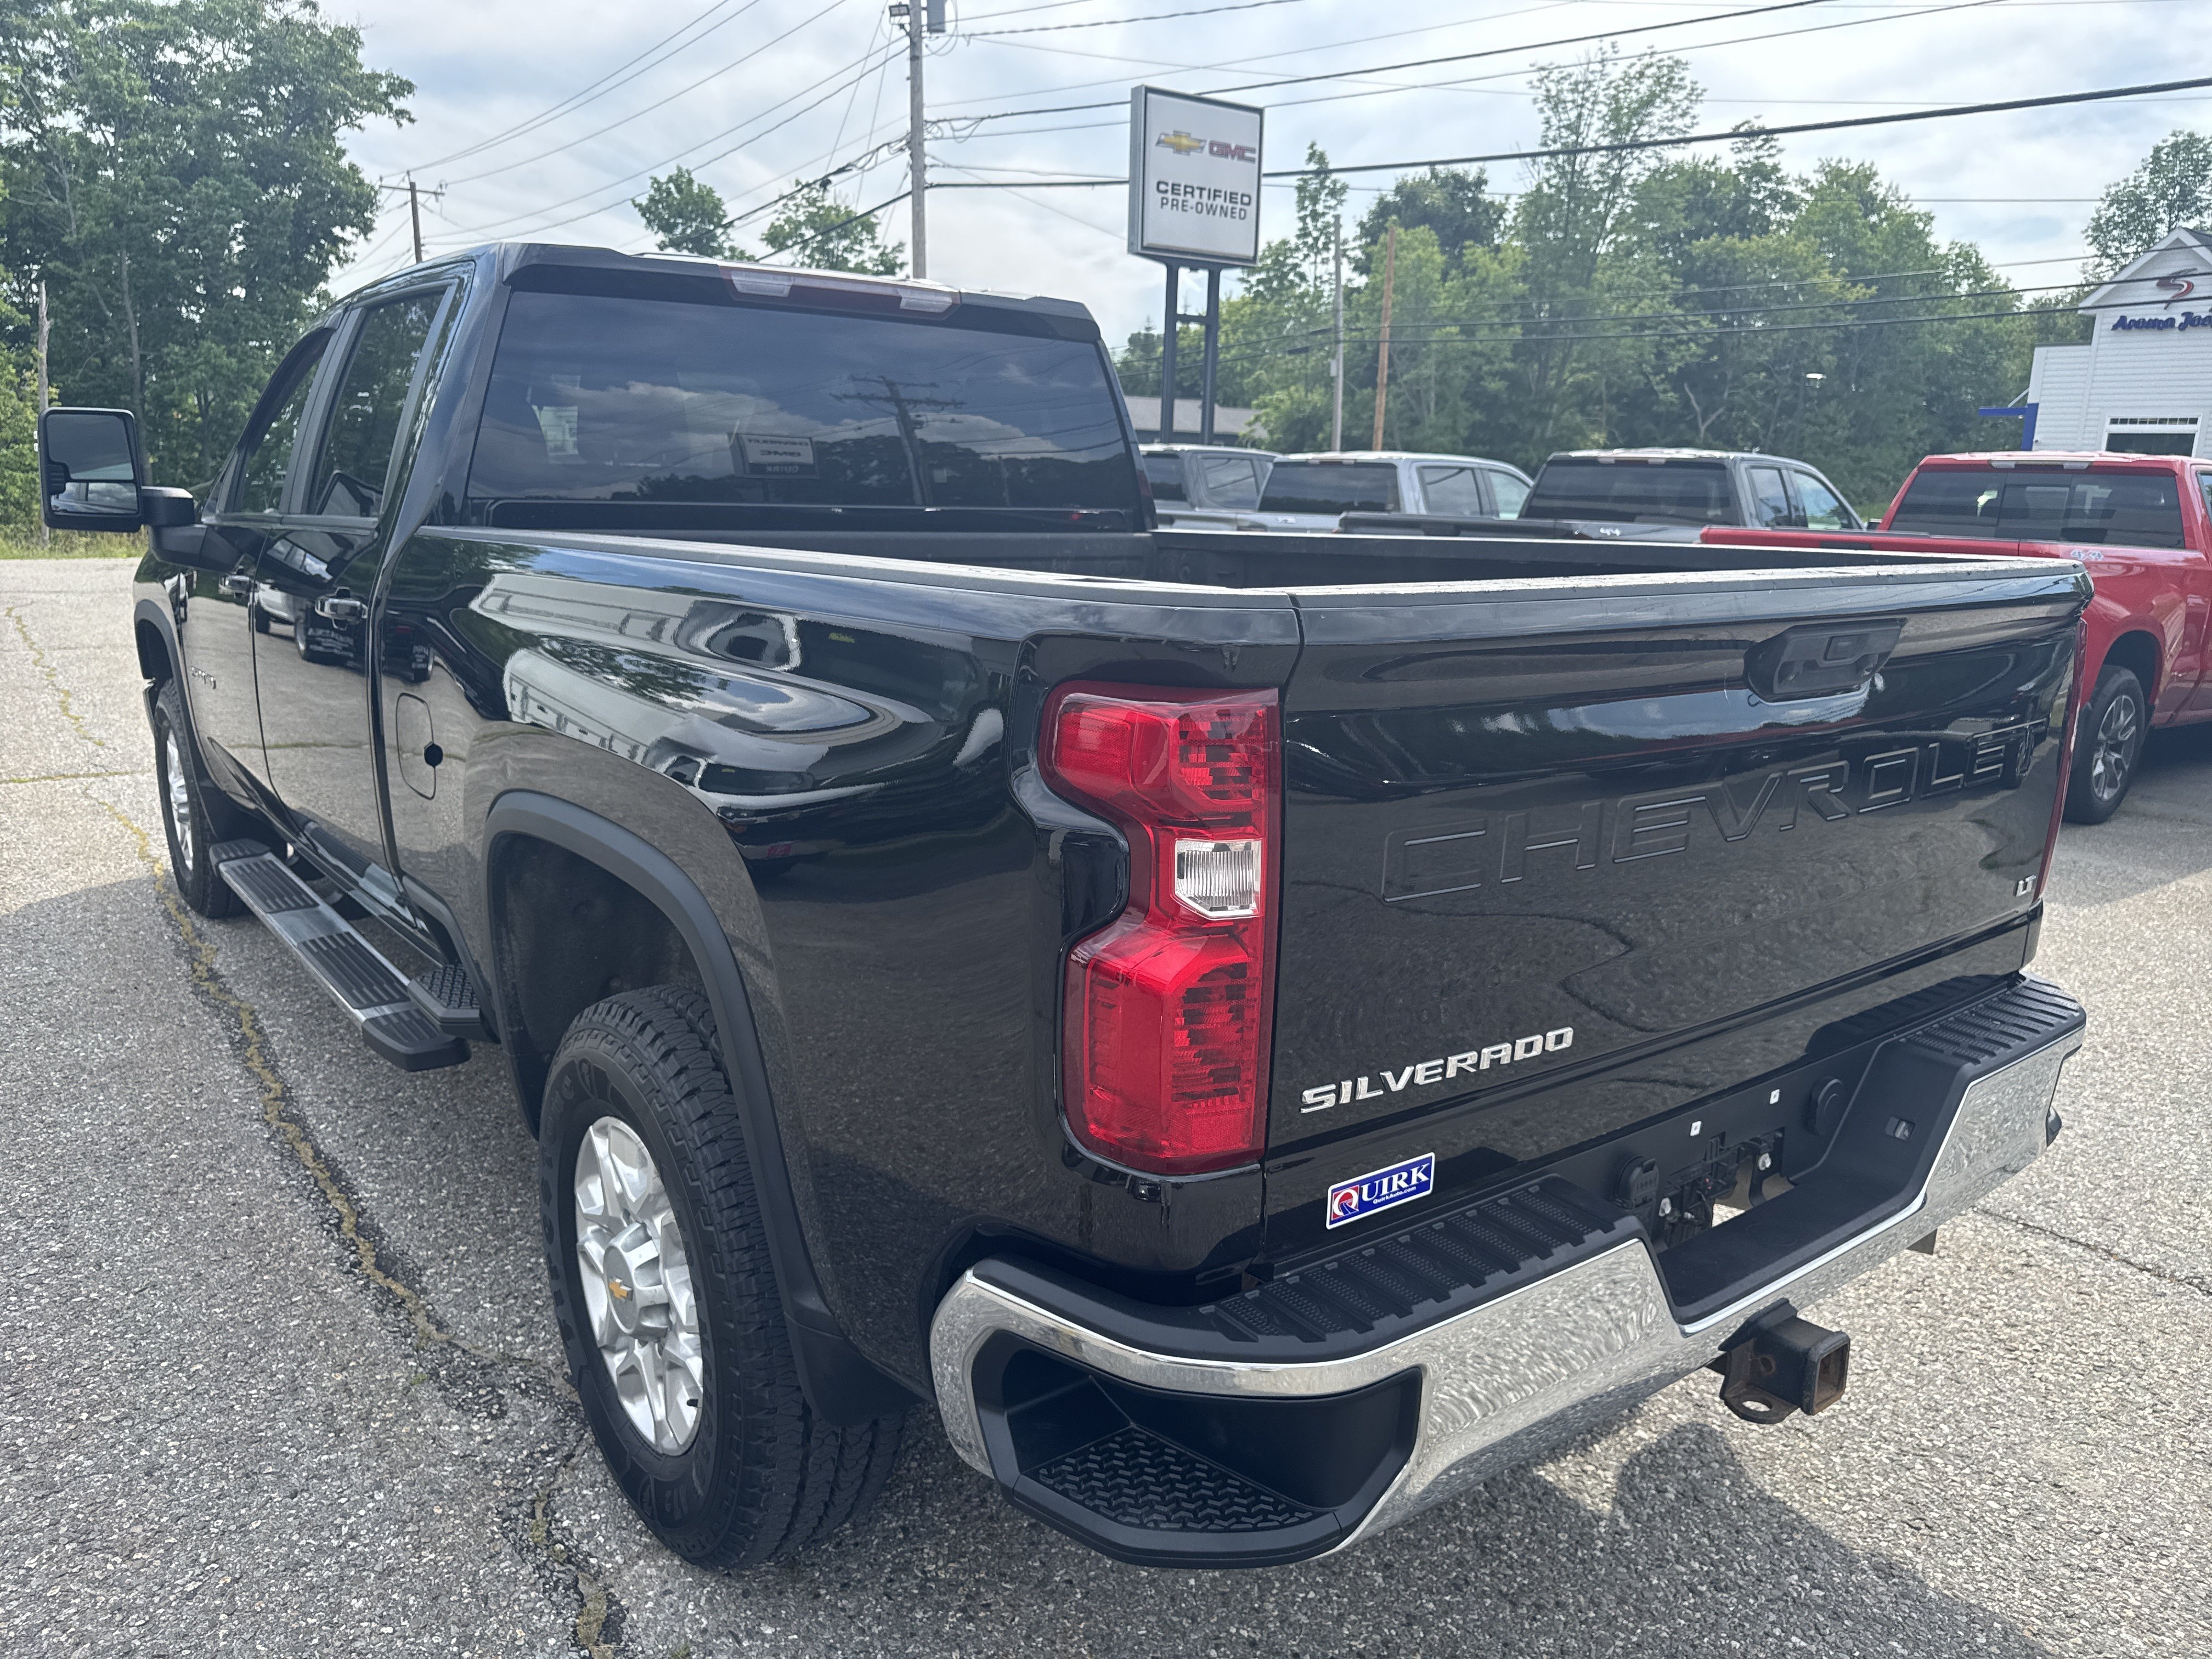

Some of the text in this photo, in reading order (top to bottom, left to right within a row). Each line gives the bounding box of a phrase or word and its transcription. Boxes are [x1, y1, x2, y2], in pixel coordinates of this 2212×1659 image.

[1209, 140, 1256, 163] GMC
[1156, 180, 1252, 207] CERTIFIED
[1160, 196, 1248, 221] PRE-OWNED
[2111, 315, 2176, 330] Aroma
[1381, 718, 2047, 902] CHEVROLET
[2015, 874, 2037, 897] LT
[1300, 1026, 1573, 1113] SILVERADO
[1333, 1163, 1430, 1216] QUIRK
[1373, 1186, 1417, 1205] QuirkAuto.com
